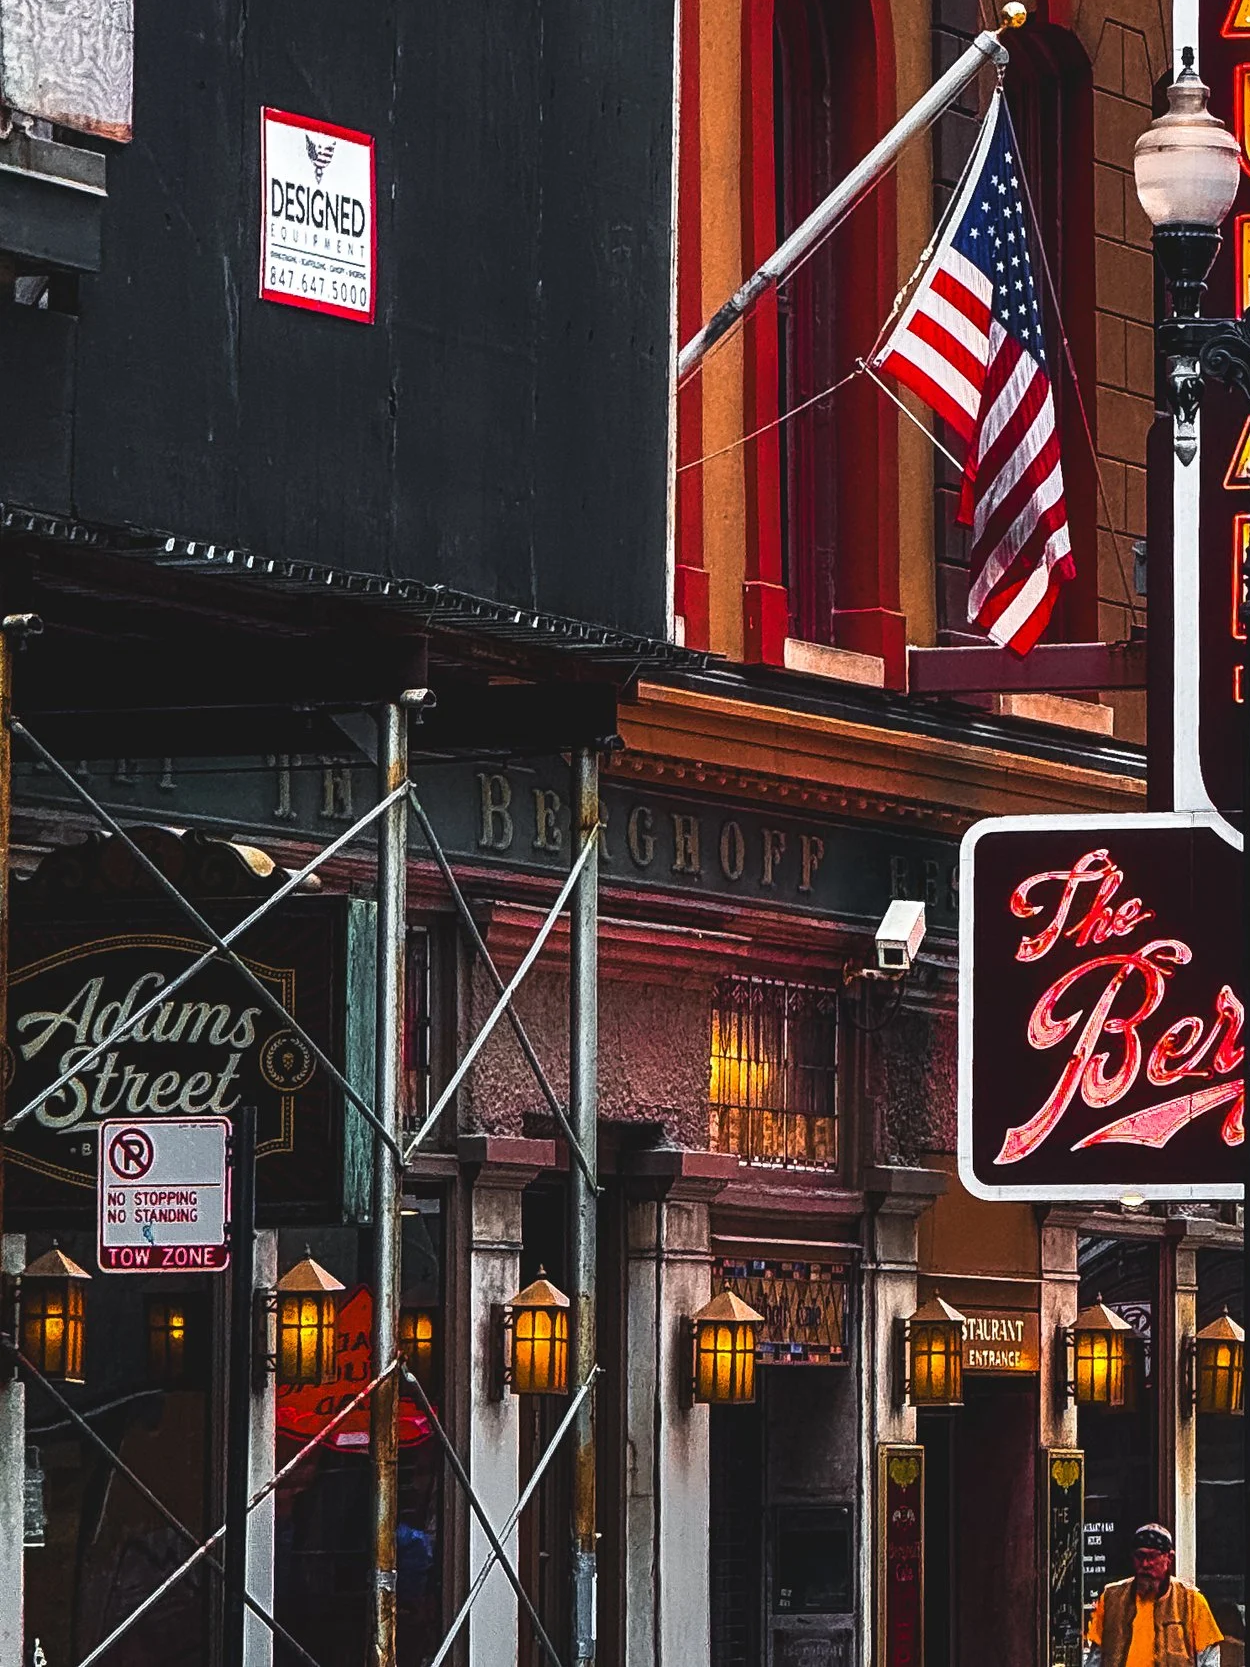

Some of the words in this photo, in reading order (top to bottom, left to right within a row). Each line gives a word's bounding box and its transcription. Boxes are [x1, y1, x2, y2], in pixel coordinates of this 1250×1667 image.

[271, 178, 366, 238] DESIGNED
[270, 223, 365, 258] EQUIPMENT
[270, 266, 367, 307] 847.647.5000
[264, 754, 357, 821] TH
[1010, 849, 1155, 962] The
[17, 972, 262, 1062] Adams
[35, 1046, 242, 1128] Street
[107, 1192, 126, 1206] NO
[134, 1191, 197, 1205] STOPPING
[107, 1210, 126, 1224] NO
[134, 1209, 198, 1223] STANDING
[109, 1248, 151, 1267] TOW
[162, 1247, 216, 1266] ZONE
[961, 1318, 1024, 1343] STAURANT
[969, 1350, 1020, 1367] ENTRANCE
